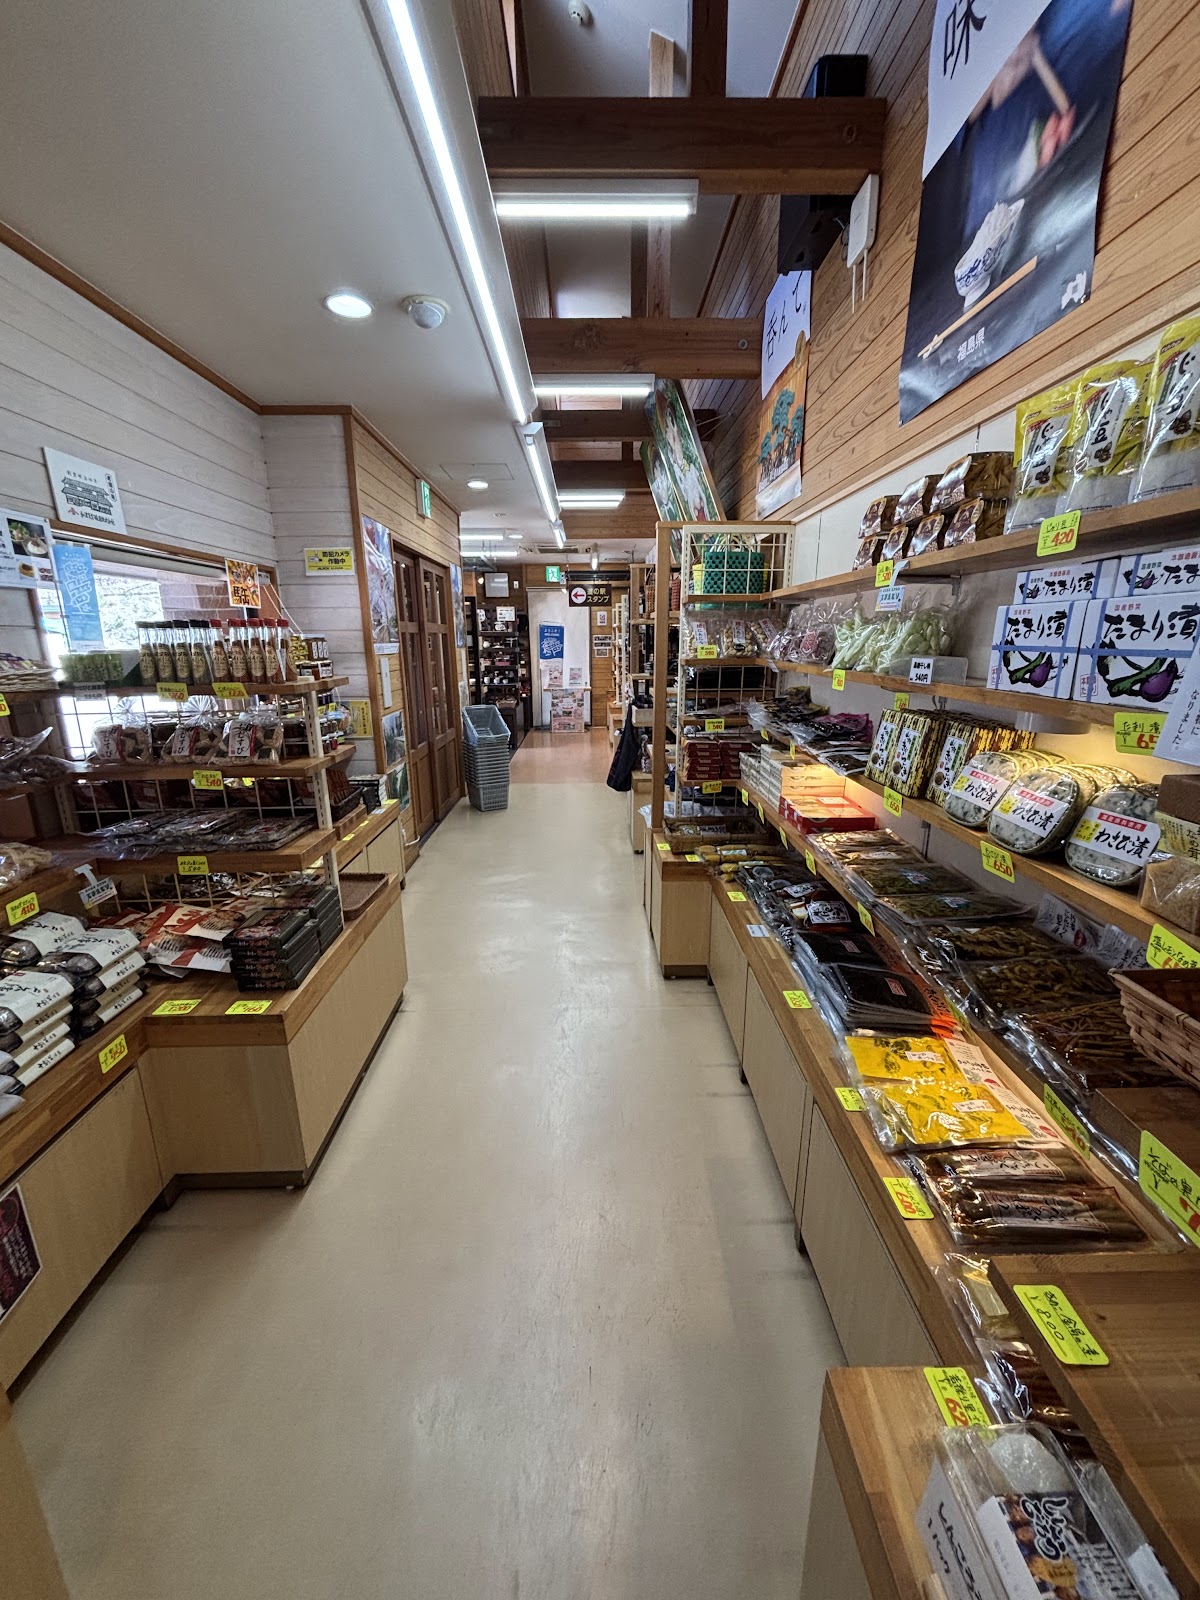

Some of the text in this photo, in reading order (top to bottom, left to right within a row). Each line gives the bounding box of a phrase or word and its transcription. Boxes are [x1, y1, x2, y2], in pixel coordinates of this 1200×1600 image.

[957, 326, 986, 364] 福島県
[1051, 529, 1075, 546] 420
[1044, 572, 1095, 596] たまり漬
[587, 595, 610, 603] スタンプ
[1114, 603, 1142, 611] 国産野菜
[1013, 608, 1031, 616] 国産野菜
[1104, 602, 1199, 643] たまり漬
[1007, 609, 1068, 640] たまり漬
[1172, 689, 1199, 751] なりました。
[964, 782, 998, 805] わさび漬
[890, 800, 900, 813] 650
[1012, 803, 1055, 831] わさび漬
[1094, 829, 1150, 859] わさび漬
[994, 860, 1013, 877] 650
[896, 1190, 917, 1214] 600
[1036, 1307, 1065, 1342] 800
